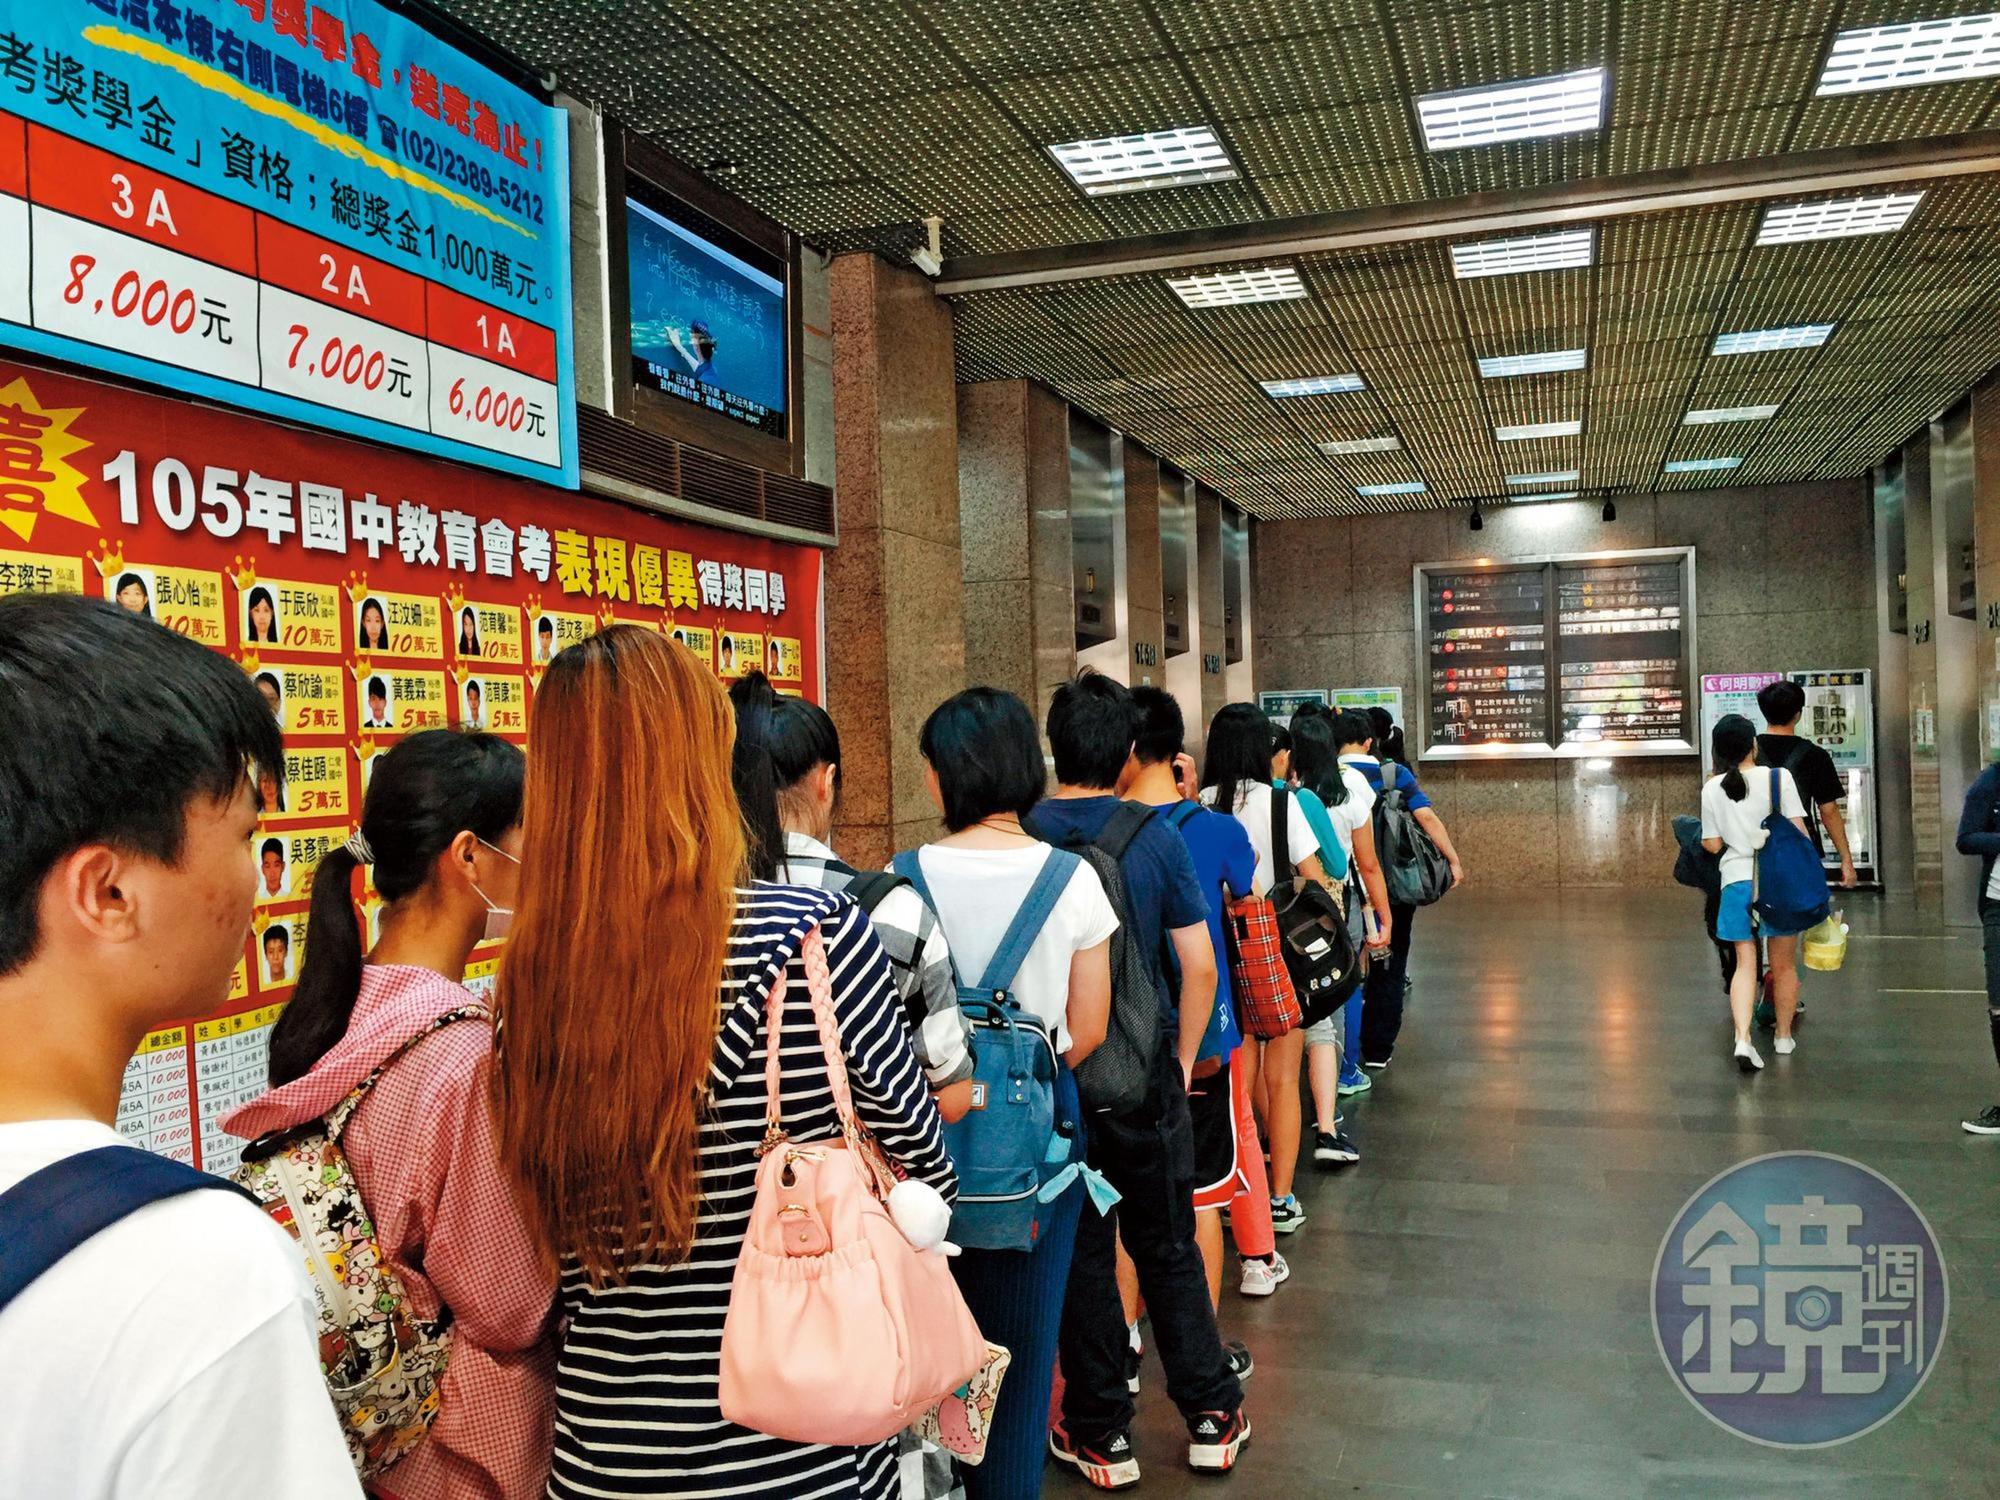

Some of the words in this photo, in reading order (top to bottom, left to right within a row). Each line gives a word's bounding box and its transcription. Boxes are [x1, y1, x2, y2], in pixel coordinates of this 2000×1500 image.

[111, 173, 178, 236] 3A
[319, 254, 371, 306] 2A
[63, 255, 233, 345] 8,000元
[476, 316, 516, 358] 1A
[287, 325, 412, 399] 7,000元
[449, 378, 546, 437] 6,000元
[156, 576, 200, 607] 張心怡
[280, 590, 320, 618] 于辰欣
[283, 625, 336, 647] 10萬元
[391, 633, 438, 653] 10萬元
[482, 641, 519, 659] 10萬元
[297, 708, 339, 728] 5萬元
[401, 709, 440, 728] 5萬元
[492, 710, 520, 728] 5萬元
[298, 790, 342, 811] 3萬元
